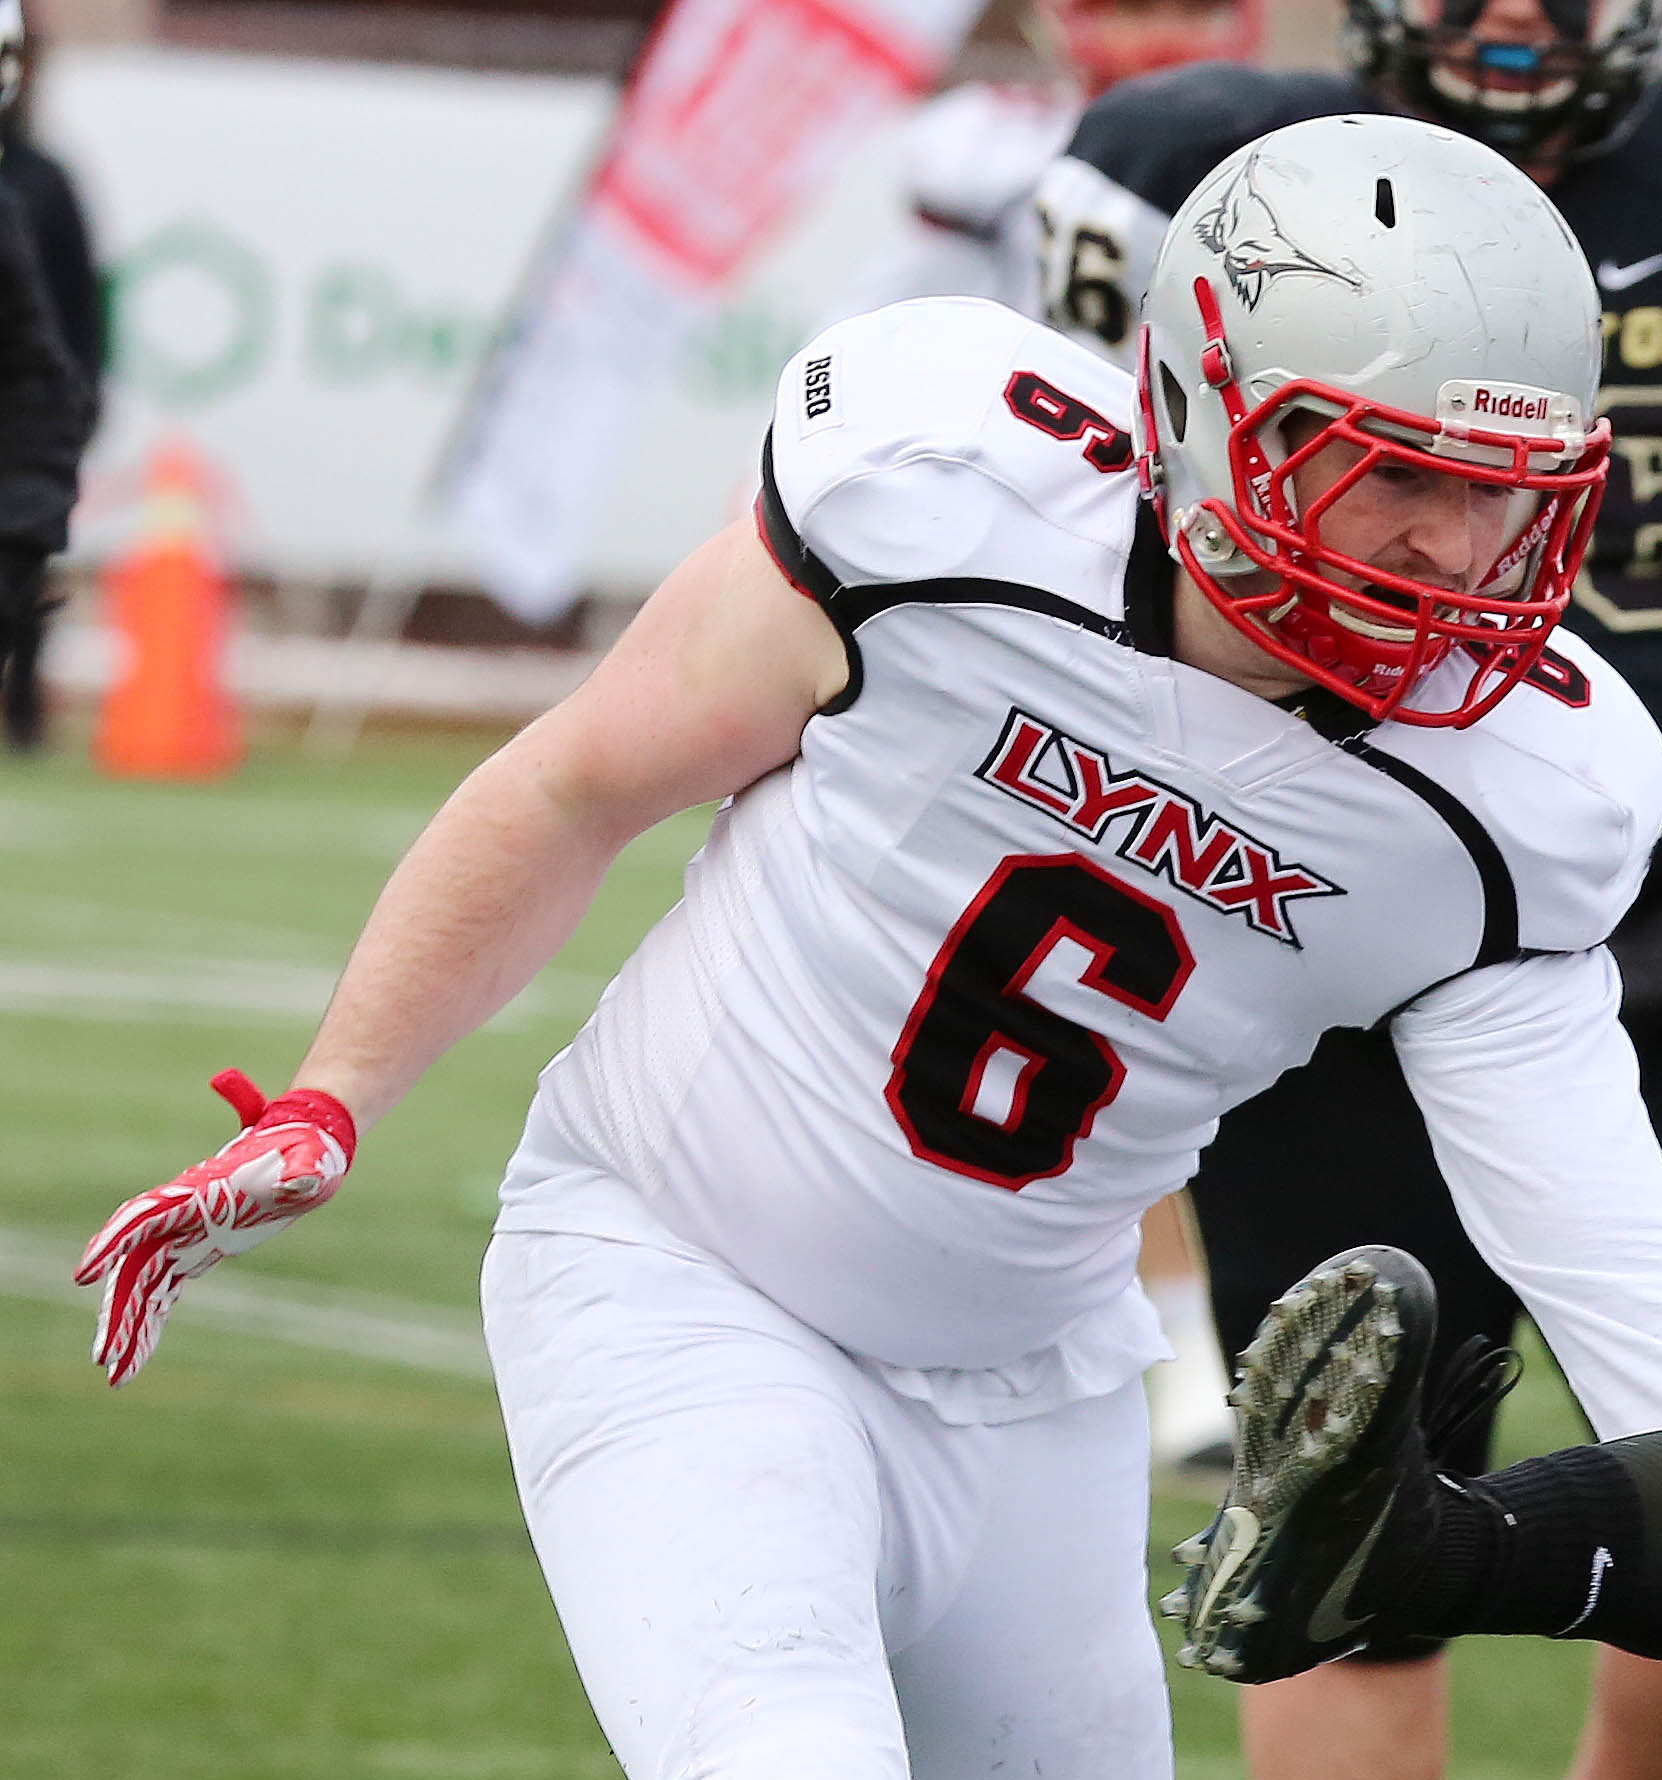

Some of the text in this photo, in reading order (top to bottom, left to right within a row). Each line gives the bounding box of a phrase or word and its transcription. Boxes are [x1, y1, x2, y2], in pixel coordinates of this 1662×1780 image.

[805, 355, 832, 420] RSEQ
[1474, 387, 1549, 421] Riddell
[972, 705, 1349, 951] LYNX
[882, 851, 1198, 1192] 6
